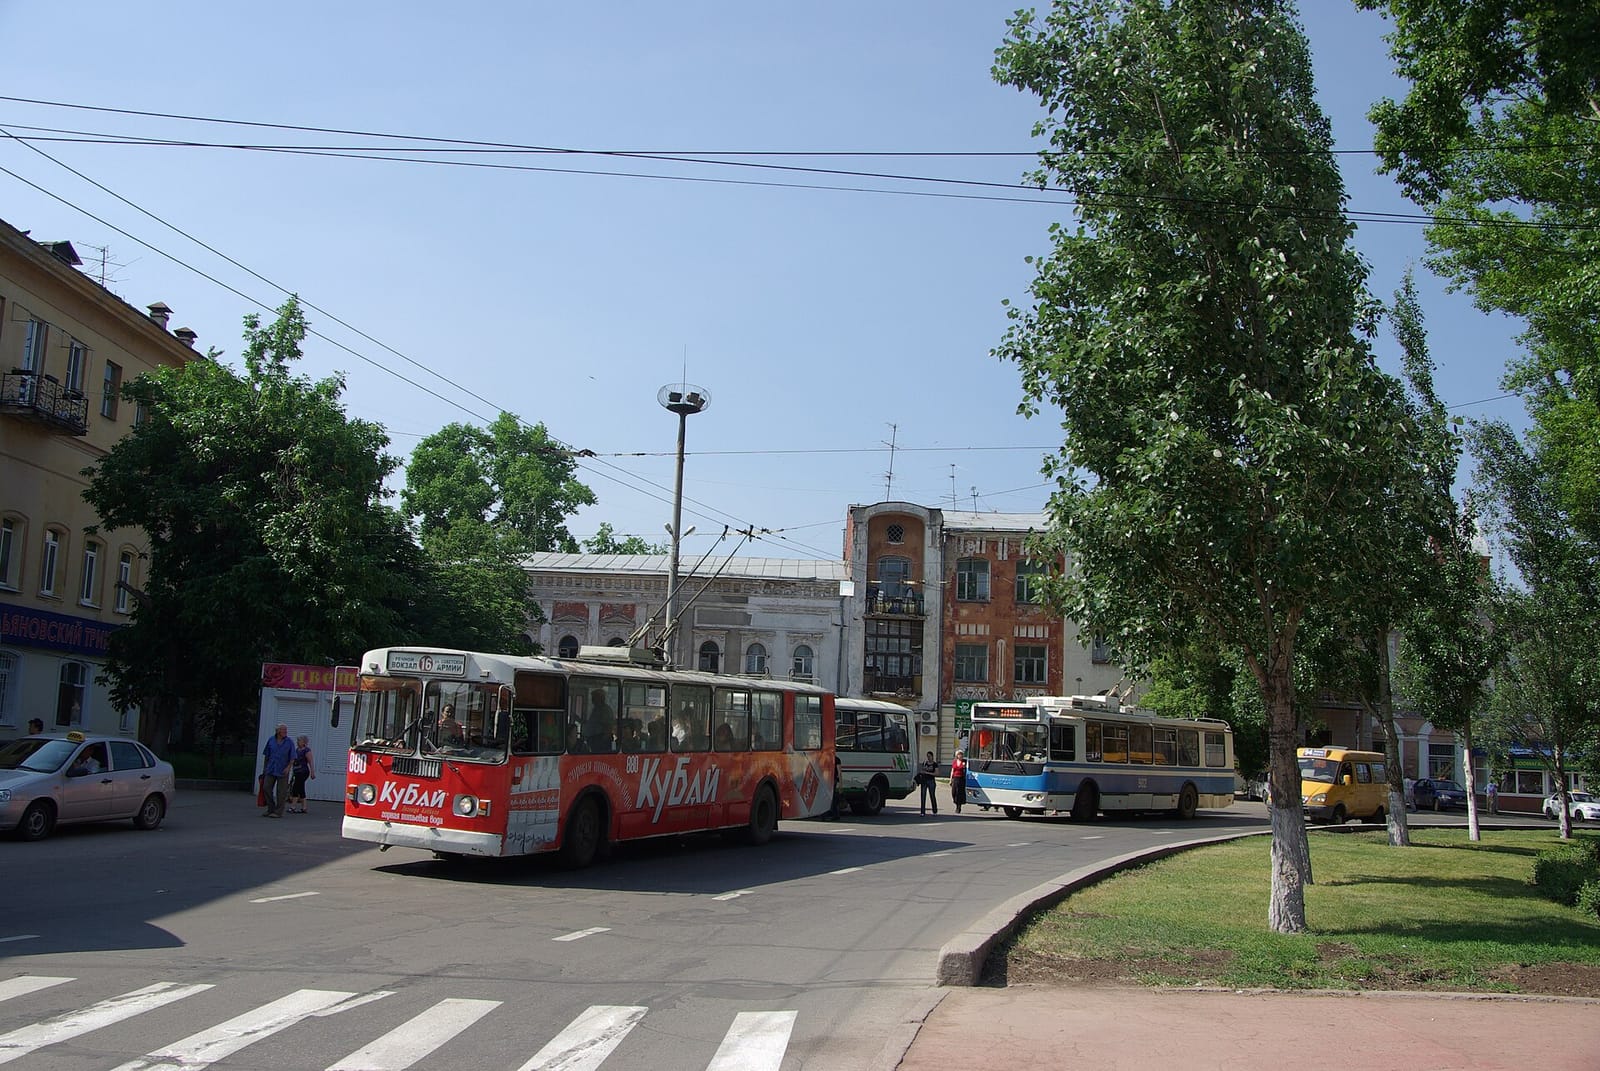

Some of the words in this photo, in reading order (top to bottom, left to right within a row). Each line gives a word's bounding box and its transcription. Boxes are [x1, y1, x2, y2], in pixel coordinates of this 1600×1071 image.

[0, 612, 82, 646] ЬЯНОВСКИЙ
[392, 661, 417, 669] ВОКЗАЛ
[421, 656, 432, 671] 16
[436, 664, 462, 672] АРМИИ
[292, 671, 355, 688] цвет
[349, 752, 367, 774] 880
[626, 755, 639, 774] 880
